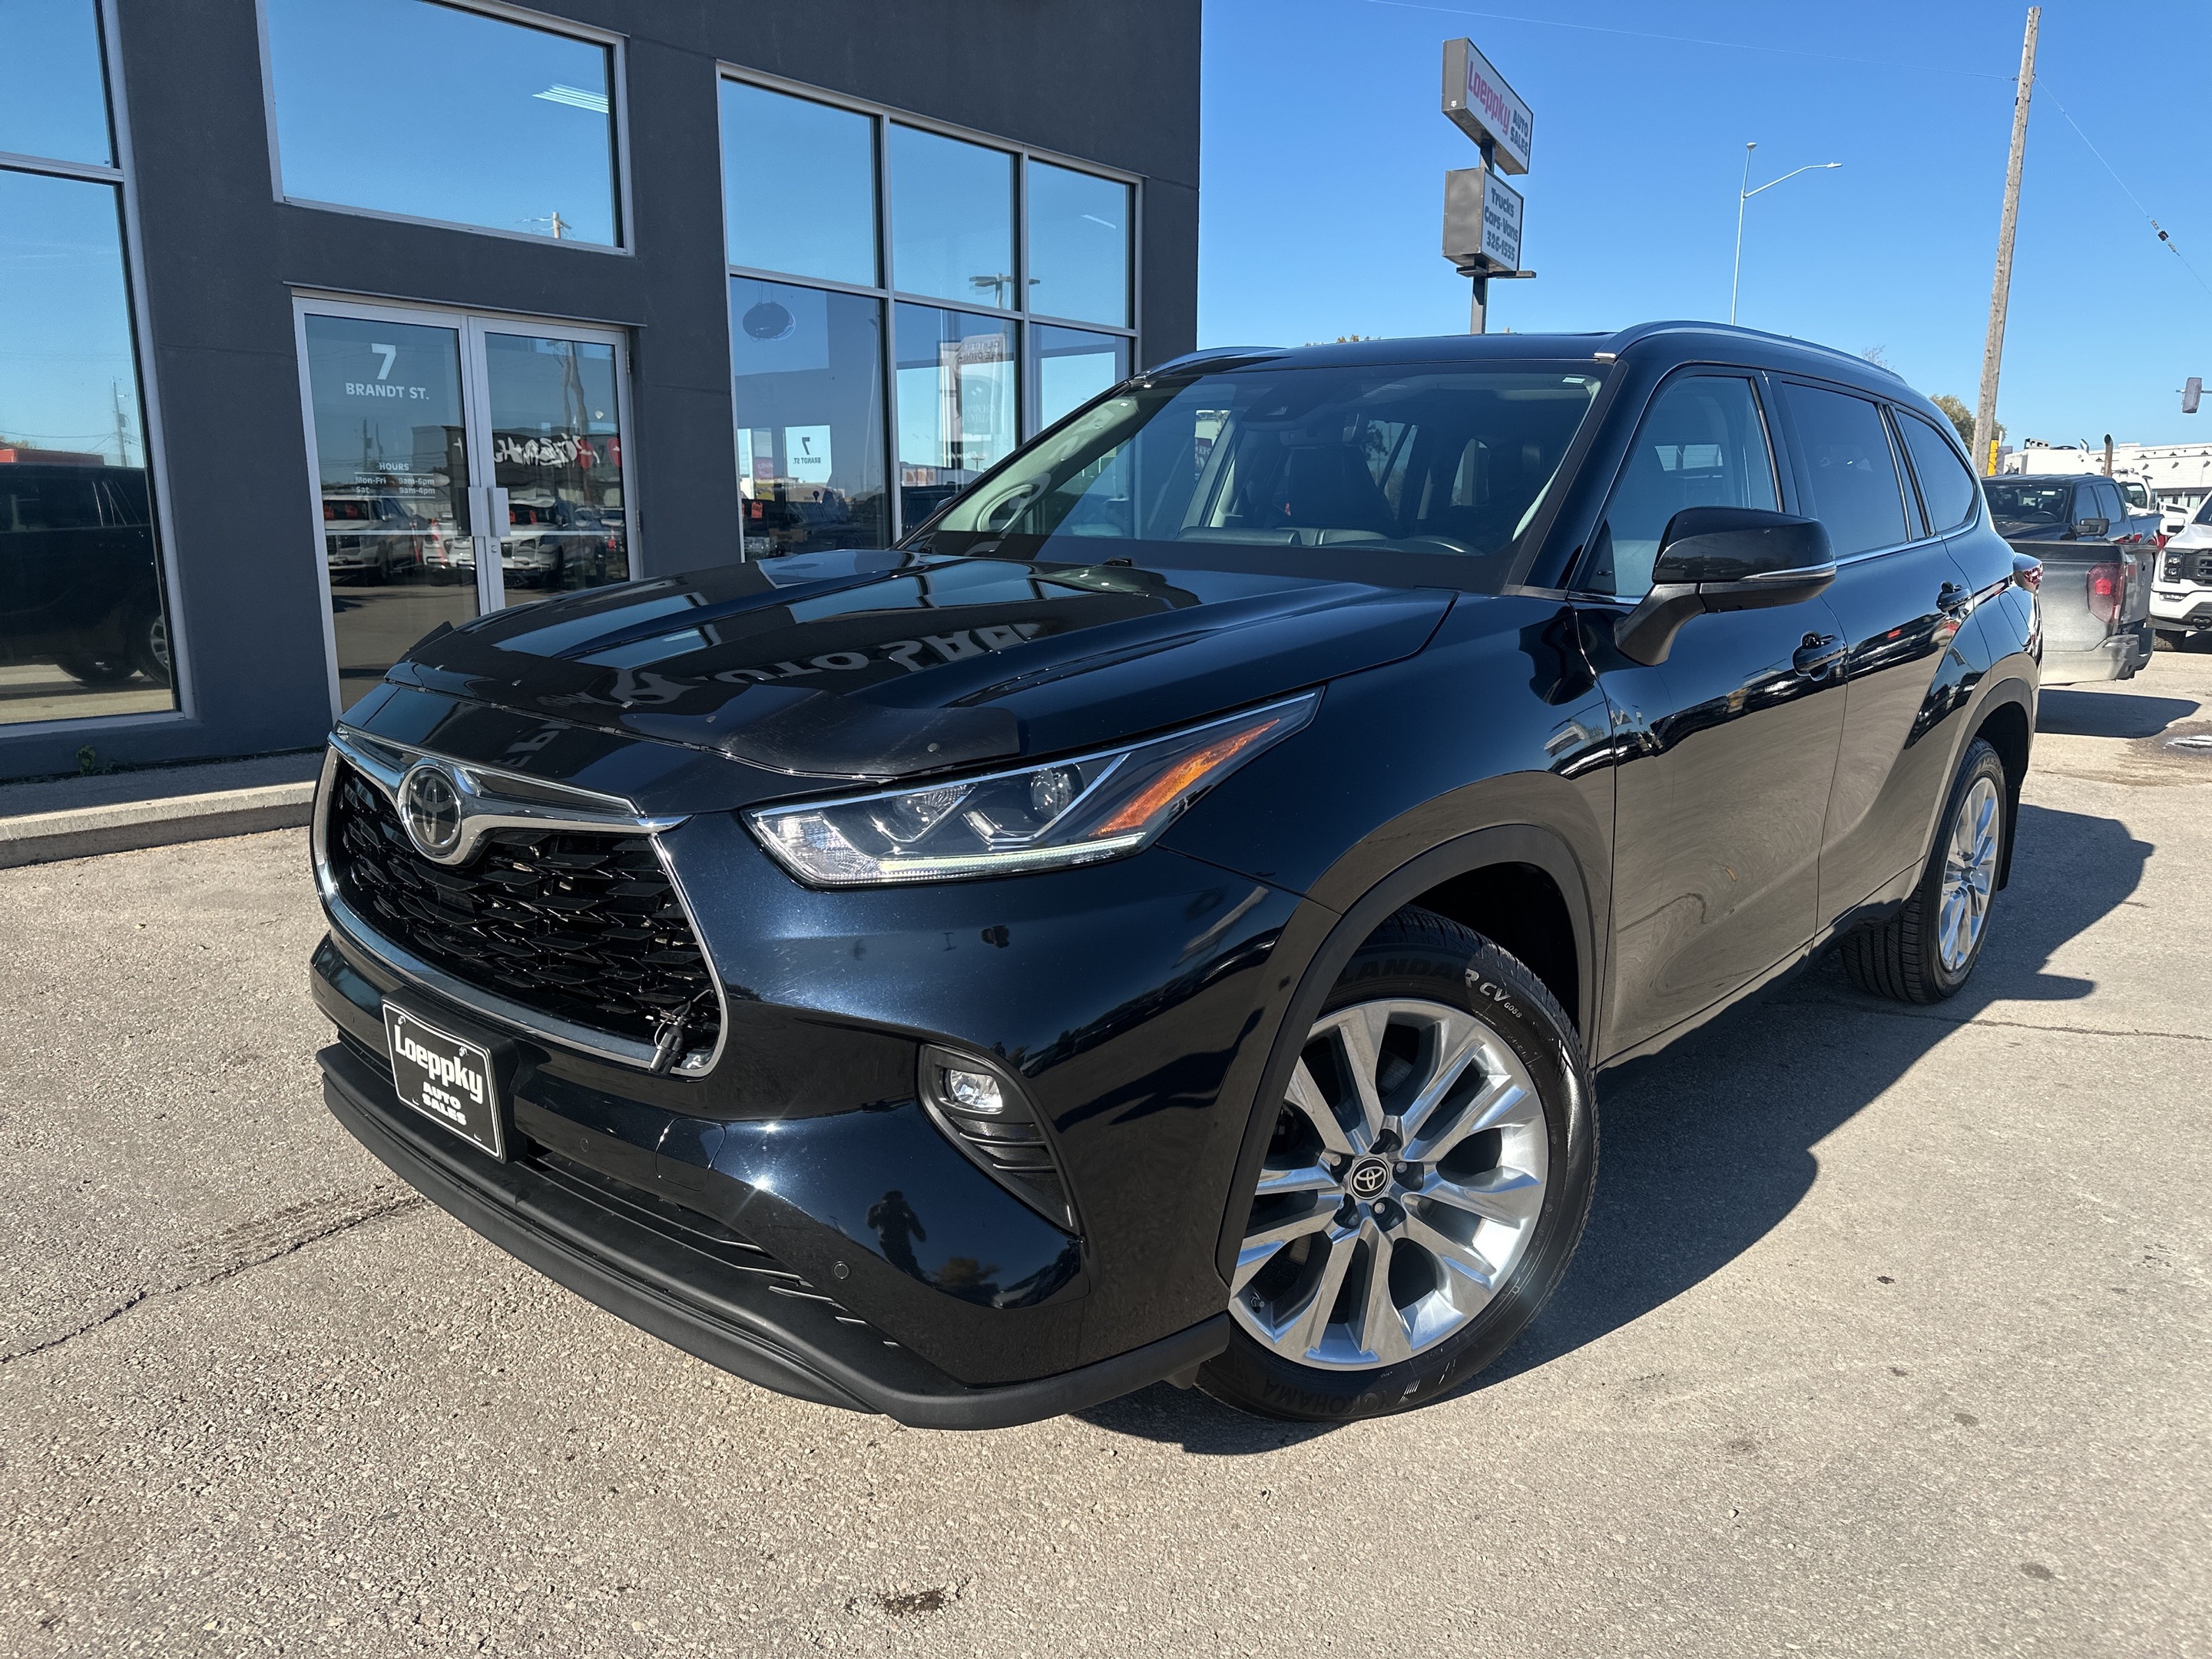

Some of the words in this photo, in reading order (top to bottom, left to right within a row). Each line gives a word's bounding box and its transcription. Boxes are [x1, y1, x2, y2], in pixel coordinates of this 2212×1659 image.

[1468, 60, 1511, 136] Loeppky
[1512, 109, 1528, 137] AUTO
[1510, 126, 1528, 157] SALES
[1491, 187, 1515, 218] Trucks
[1486, 230, 1515, 262] 326-1555
[371, 343, 396, 380] 7
[346, 382, 405, 398] BRANDT
[409, 386, 429, 399] ST.
[379, 462, 409, 471] HOURS
[399, 477, 435, 485] 9am-6pm
[399, 487, 435, 495] 9am-4pm
[1479, 982, 1512, 1002] CV
[394, 1025, 483, 1104] Loeppky
[422, 1092, 467, 1126] SALES
[423, 1081, 461, 1110] AUTO
[1261, 1377, 1392, 1415] YOKOHAMA
